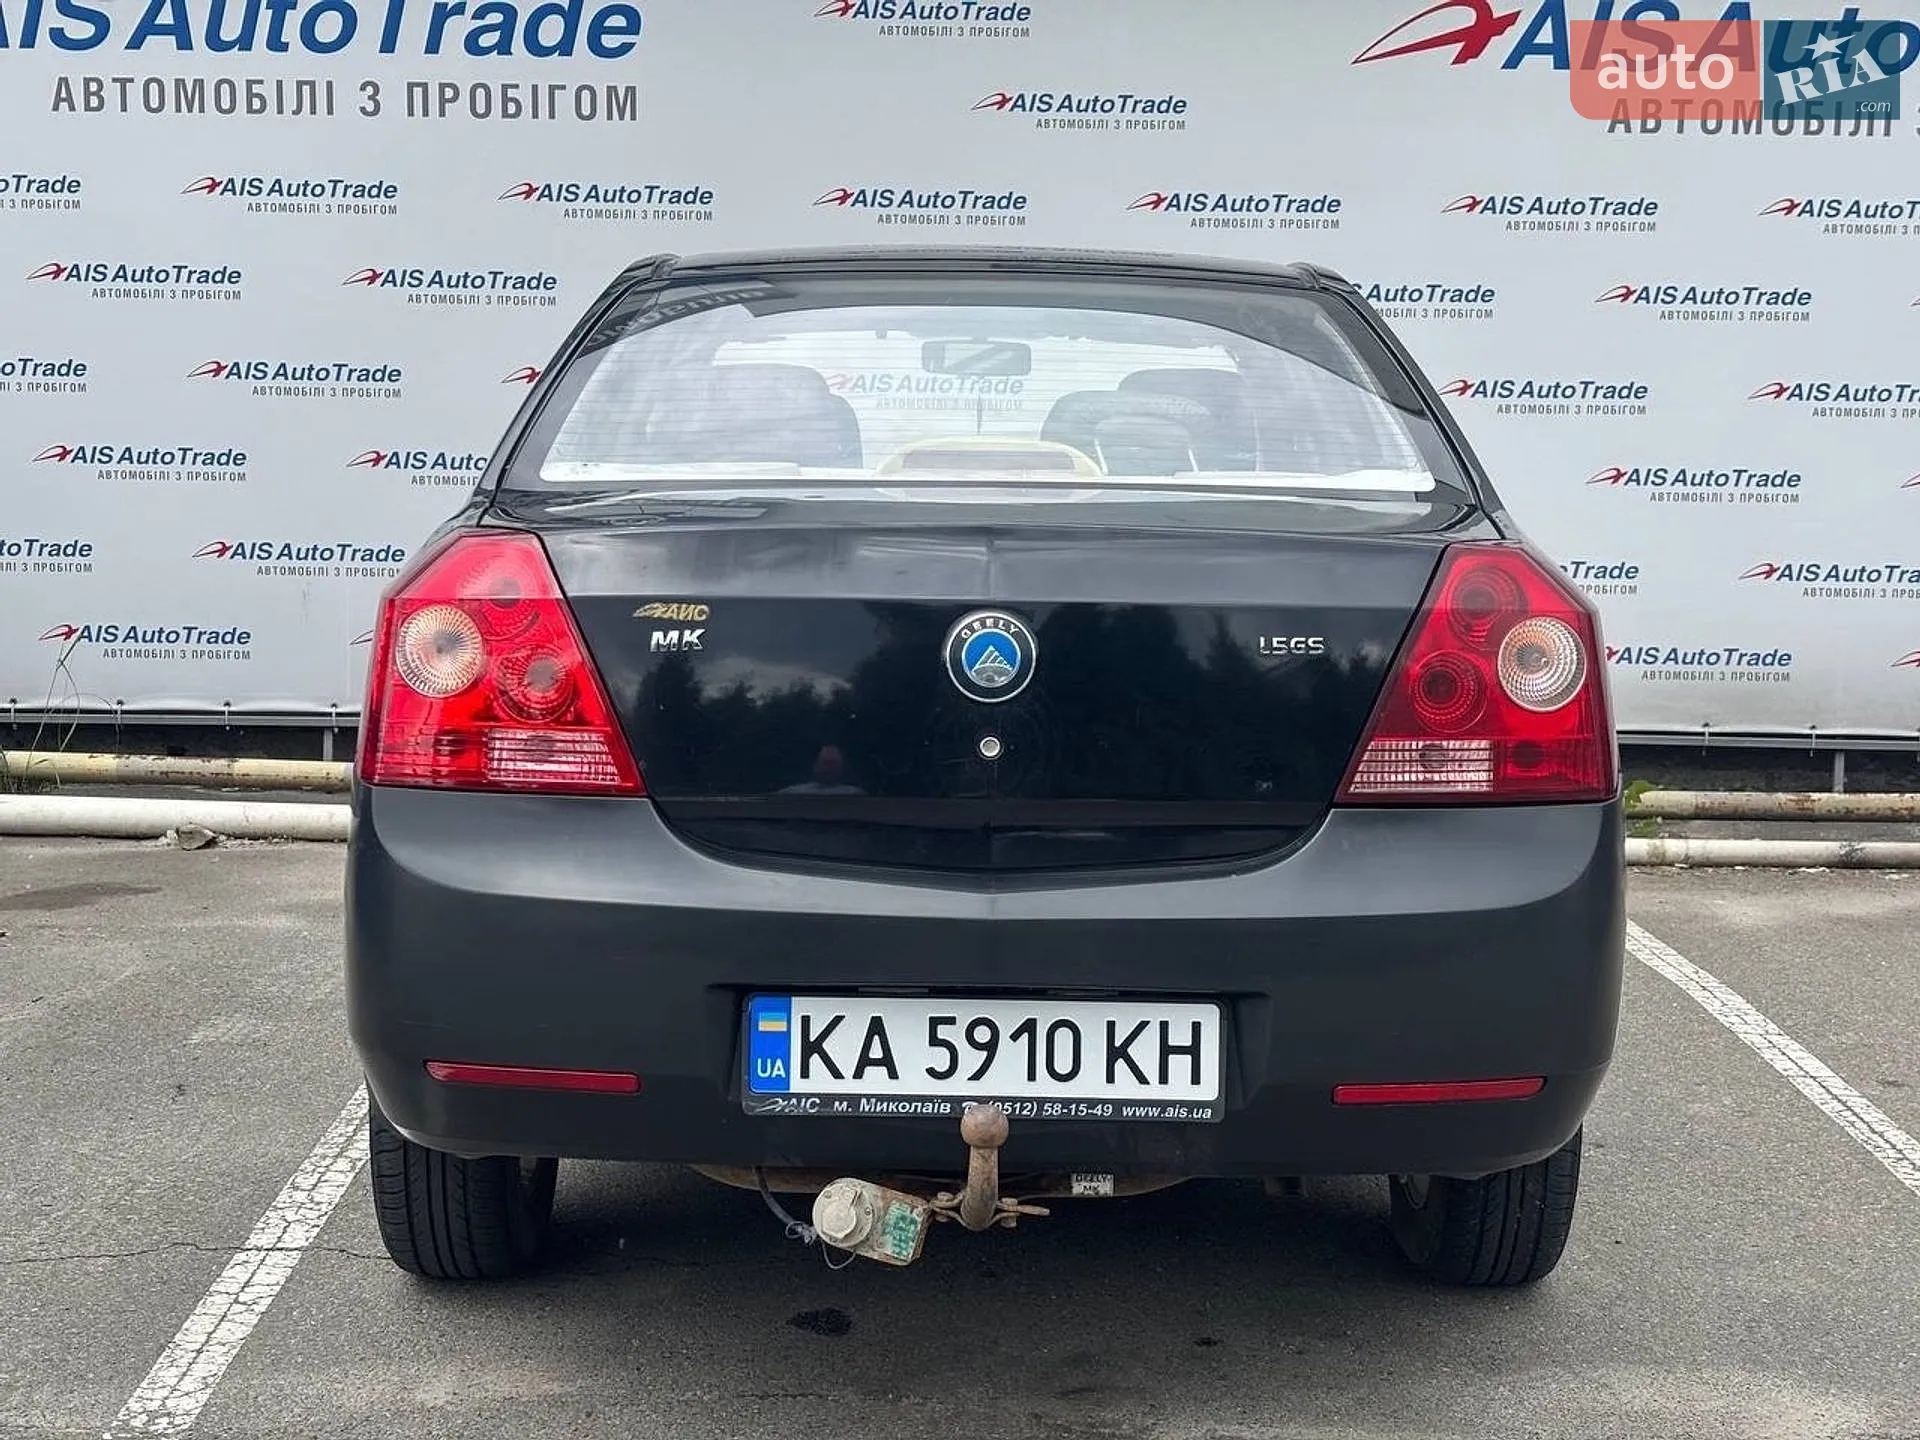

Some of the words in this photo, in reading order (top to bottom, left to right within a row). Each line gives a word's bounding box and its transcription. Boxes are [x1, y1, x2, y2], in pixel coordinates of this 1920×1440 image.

[852, 0, 895, 20] AIS
[0, 0, 111, 51] IS
[51, 76, 335, 116] АВТОМОБІЛІ
[406, 81, 638, 121] ПРОБІГОМ
[1009, 93, 1053, 112] AIS
[220, 177, 263, 196] AIS
[538, 184, 580, 202] AIS
[852, 189, 895, 208] AIS
[1164, 193, 1208, 212] AIS
[1480, 196, 1524, 214] AIS
[1798, 199, 1842, 218] AIS
[65, 264, 108, 282] AIS
[381, 269, 424, 287] AIS
[1634, 286, 1678, 305] AIS
[225, 362, 268, 380] AIS
[1471, 380, 1514, 398] AIS
[1787, 383, 1831, 401] AIS
[71, 446, 114, 464] AIS
[384, 452, 427, 469] AIS
[1624, 468, 1668, 486] AIS
[230, 542, 273, 560] AIS
[1776, 564, 1820, 582] AIS
[78, 625, 119, 643] AIS
[1616, 647, 1658, 665] AIS
[926, 1015, 1082, 1083] 5910
[757, 1058, 786, 1078] UA
[859, 1097, 951, 1114] Миколаїв
[1043, 1102, 1113, 1117] 58-15-49
[1122, 1104, 1213, 1119] www.ais.ua
